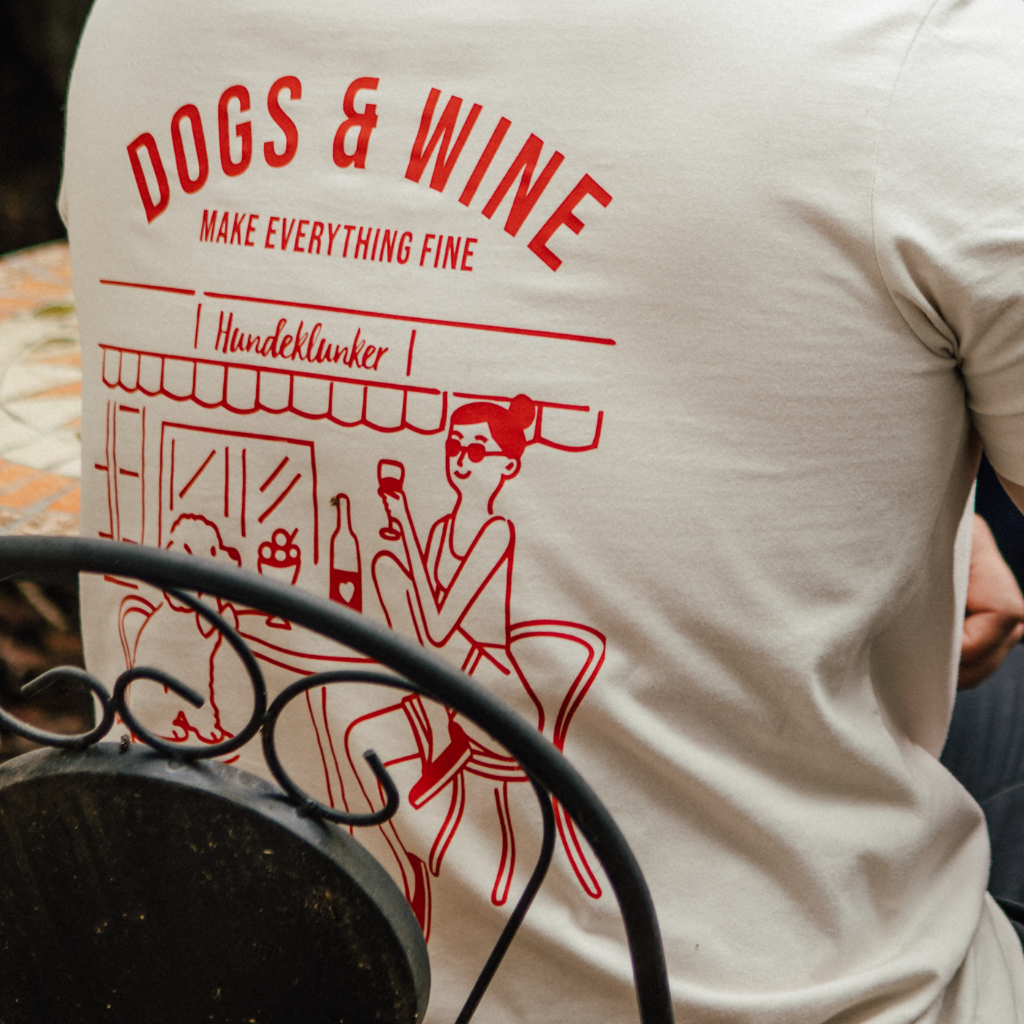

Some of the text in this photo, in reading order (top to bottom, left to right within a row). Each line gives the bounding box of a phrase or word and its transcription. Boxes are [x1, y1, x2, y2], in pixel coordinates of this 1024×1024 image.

[125, 75, 613, 273] DOGS & WINE
[200, 209, 478, 272] MAKE EVERYTHING FINE
[215, 311, 389, 372] Hundeklunker
